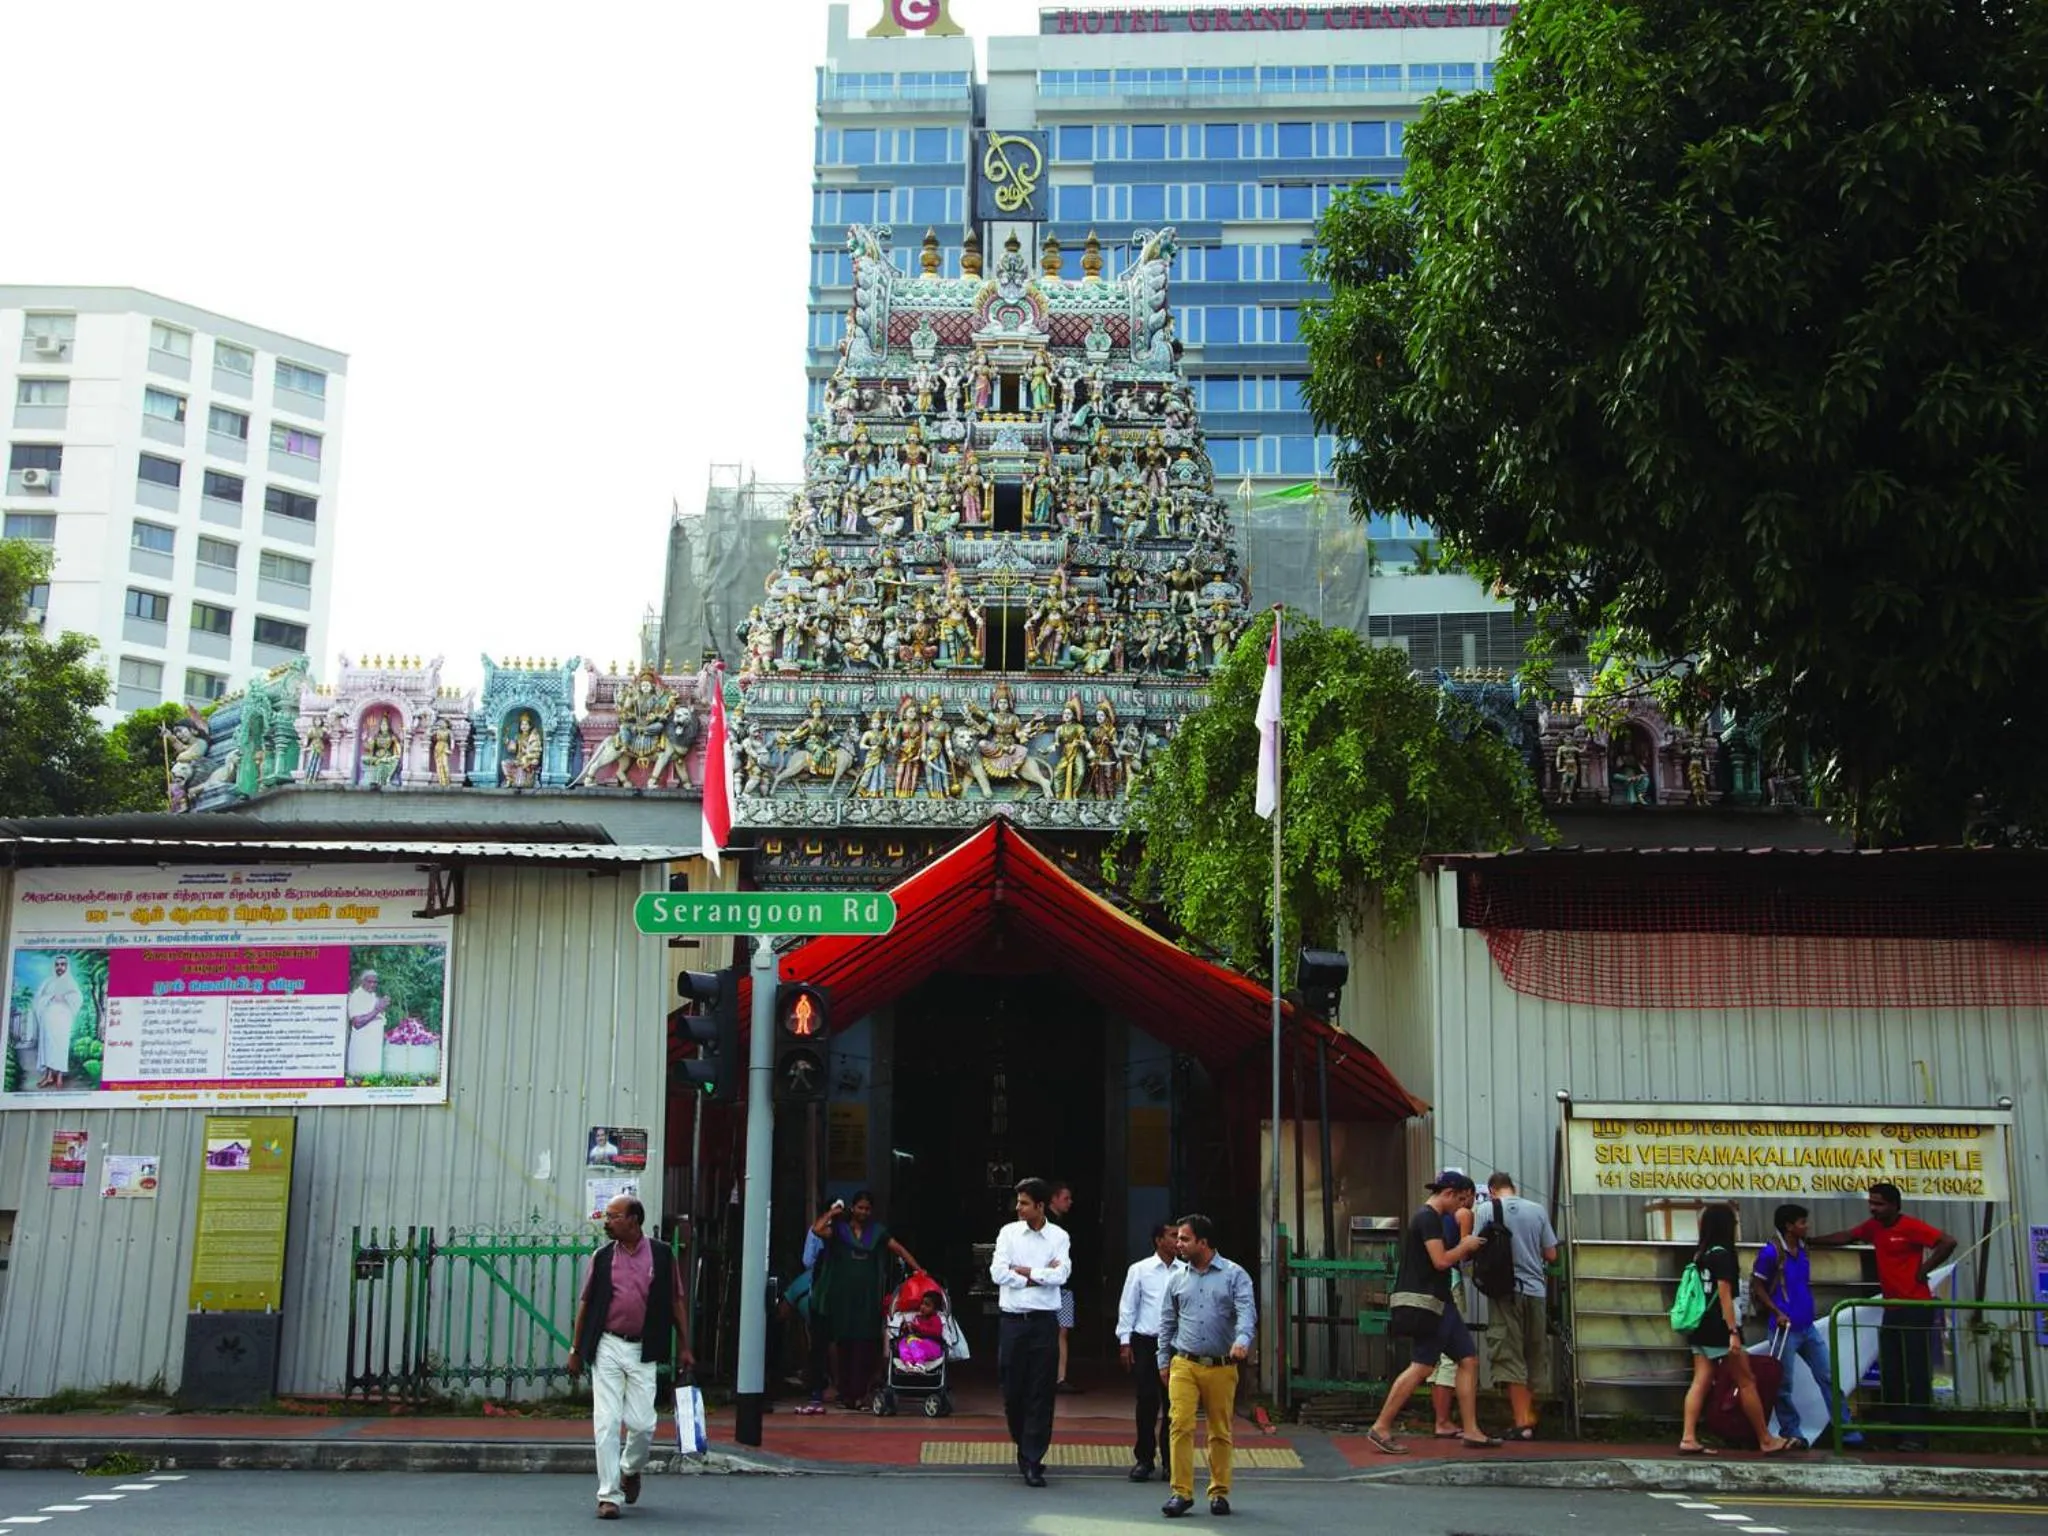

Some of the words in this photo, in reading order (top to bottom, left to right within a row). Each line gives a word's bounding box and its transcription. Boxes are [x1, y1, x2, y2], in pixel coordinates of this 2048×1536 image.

[1057, 10, 1169, 34] HOTEL
[1188, 7, 1307, 32] GRAND
[1325, 4, 1519, 29] CHANCELL
[653, 897, 822, 929] Serangoon
[844, 897, 878, 923] Rd
[1595, 1144, 1632, 1164] SRI
[1637, 1144, 1884, 1168] VEERAMAKALIAMMAN
[1889, 1150, 1983, 1171] TEMPLE
[1595, 1172, 1622, 1187] 141
[1629, 1171, 1743, 1190] SERANGOON
[1749, 1173, 1806, 1193] ROAD,
[1922, 1176, 1984, 1195] 218042
